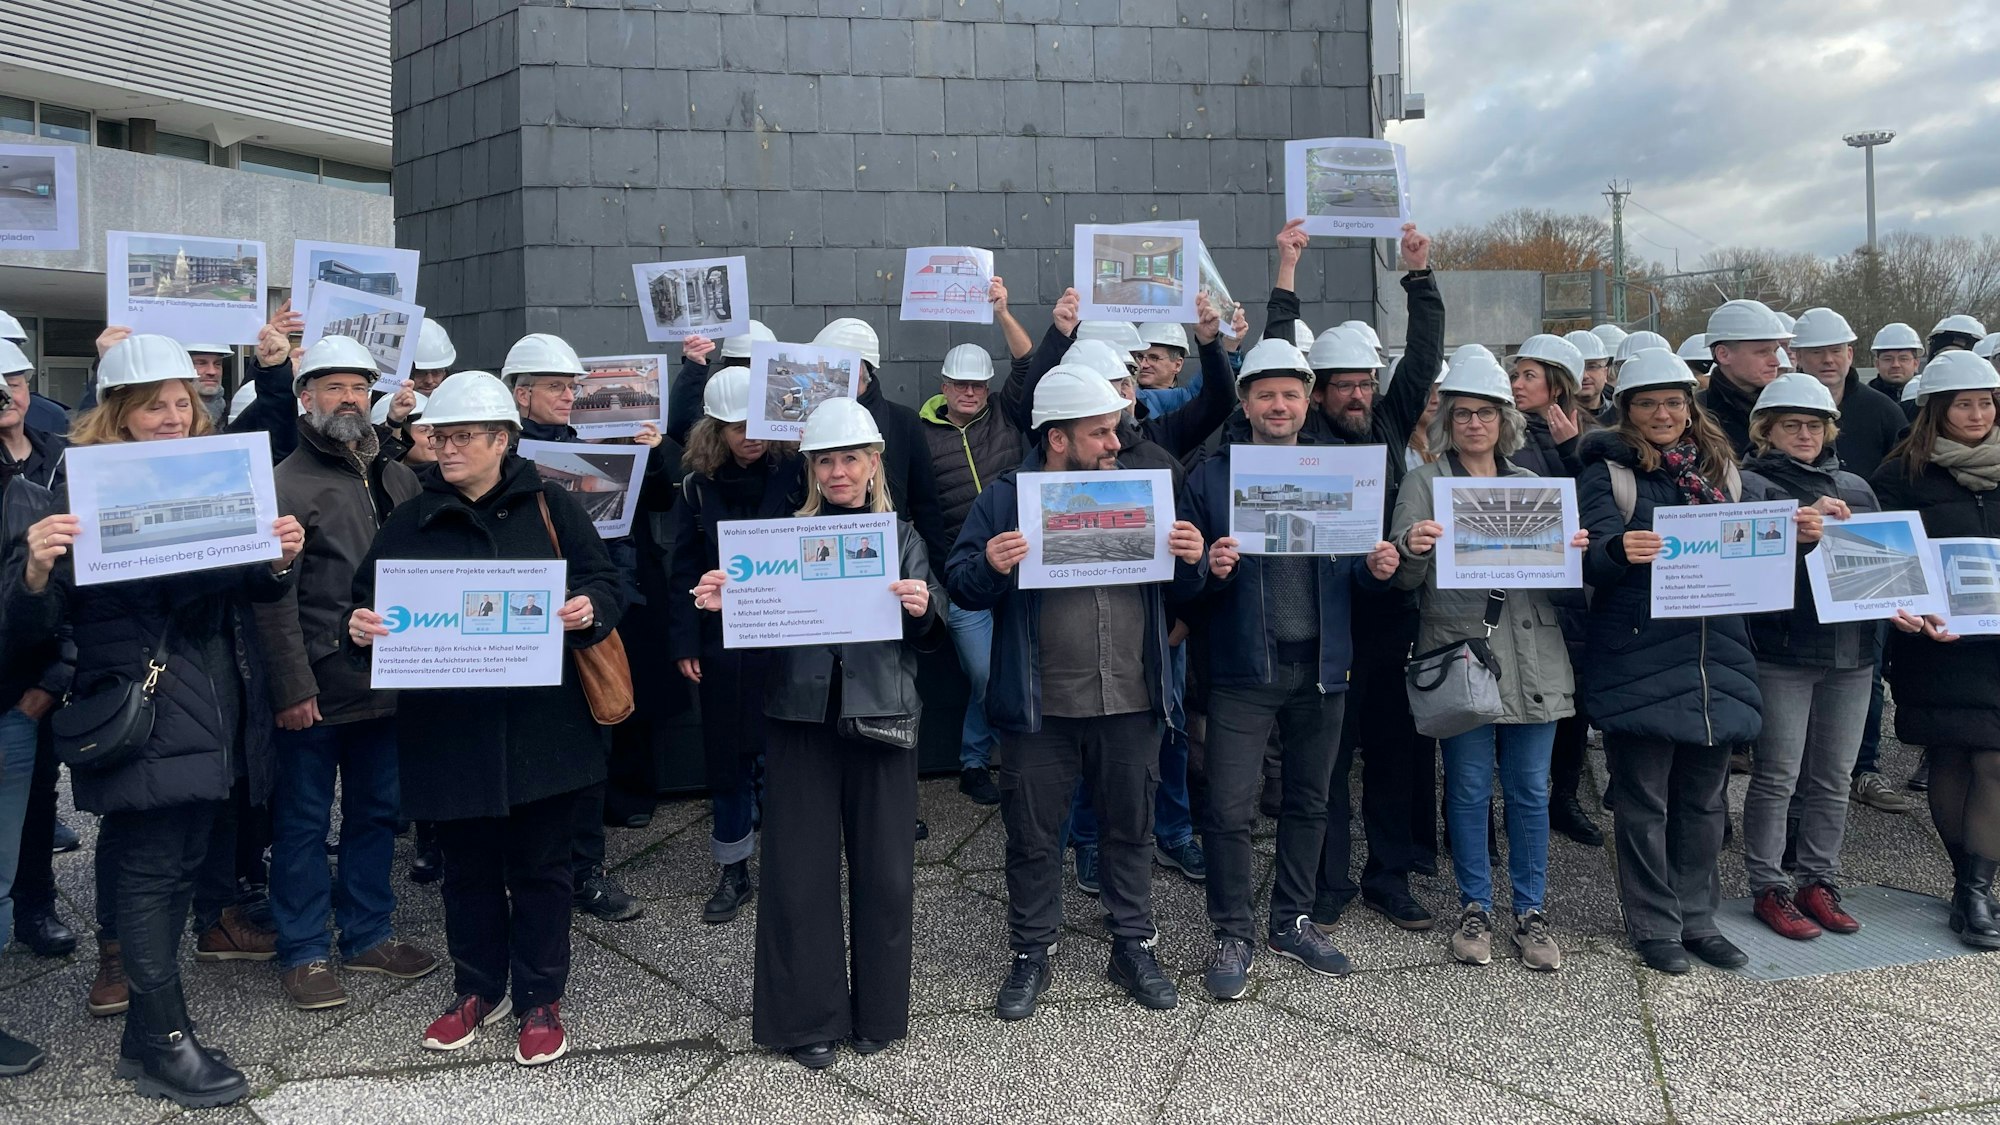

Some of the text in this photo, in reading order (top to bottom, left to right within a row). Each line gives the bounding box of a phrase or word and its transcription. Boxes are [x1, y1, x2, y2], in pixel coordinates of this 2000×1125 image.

[1333, 220, 1374, 229] Bürgerbüro
[0, 232, 35, 242] pladen
[128, 298, 258, 310] Erweiterung Flüchtlingsunterkunft Sandstraße
[1122, 306, 1170, 315] Wuppermann
[770, 424, 788, 432] GGS
[1299, 457, 1320, 466] 2021
[1354, 479, 1378, 487] 2020
[1718, 510, 1743, 518] Projekte
[1744, 508, 1768, 516] verkauft
[1768, 506, 1793, 514] werden?
[723, 520, 890, 536] Wohin sollen unsere Projekte verkauft werden?
[88, 540, 271, 572] Werner-Heisenberg Gymnasium
[455, 567, 485, 575] Projekte
[1049, 566, 1147, 578] GGS Theodor-Fontane
[1455, 570, 1565, 580] Landrat-Lucas Gymnasium
[726, 586, 777, 594] Geschäftsführer:
[1854, 599, 1914, 611] Feuerwache Süd
[779, 619, 825, 627] Aufsichtsrates:
[379, 645, 433, 653] Geschäftsführer:
[434, 644, 452, 654] Björn
[453, 644, 481, 652] Krischick
[434, 656, 482, 664] Aufsichtsrates:
[483, 656, 504, 664] Stefan
[377, 667, 451, 675] (Fraktionsvorsitzender
[467, 666, 506, 674] Leverkusen)
